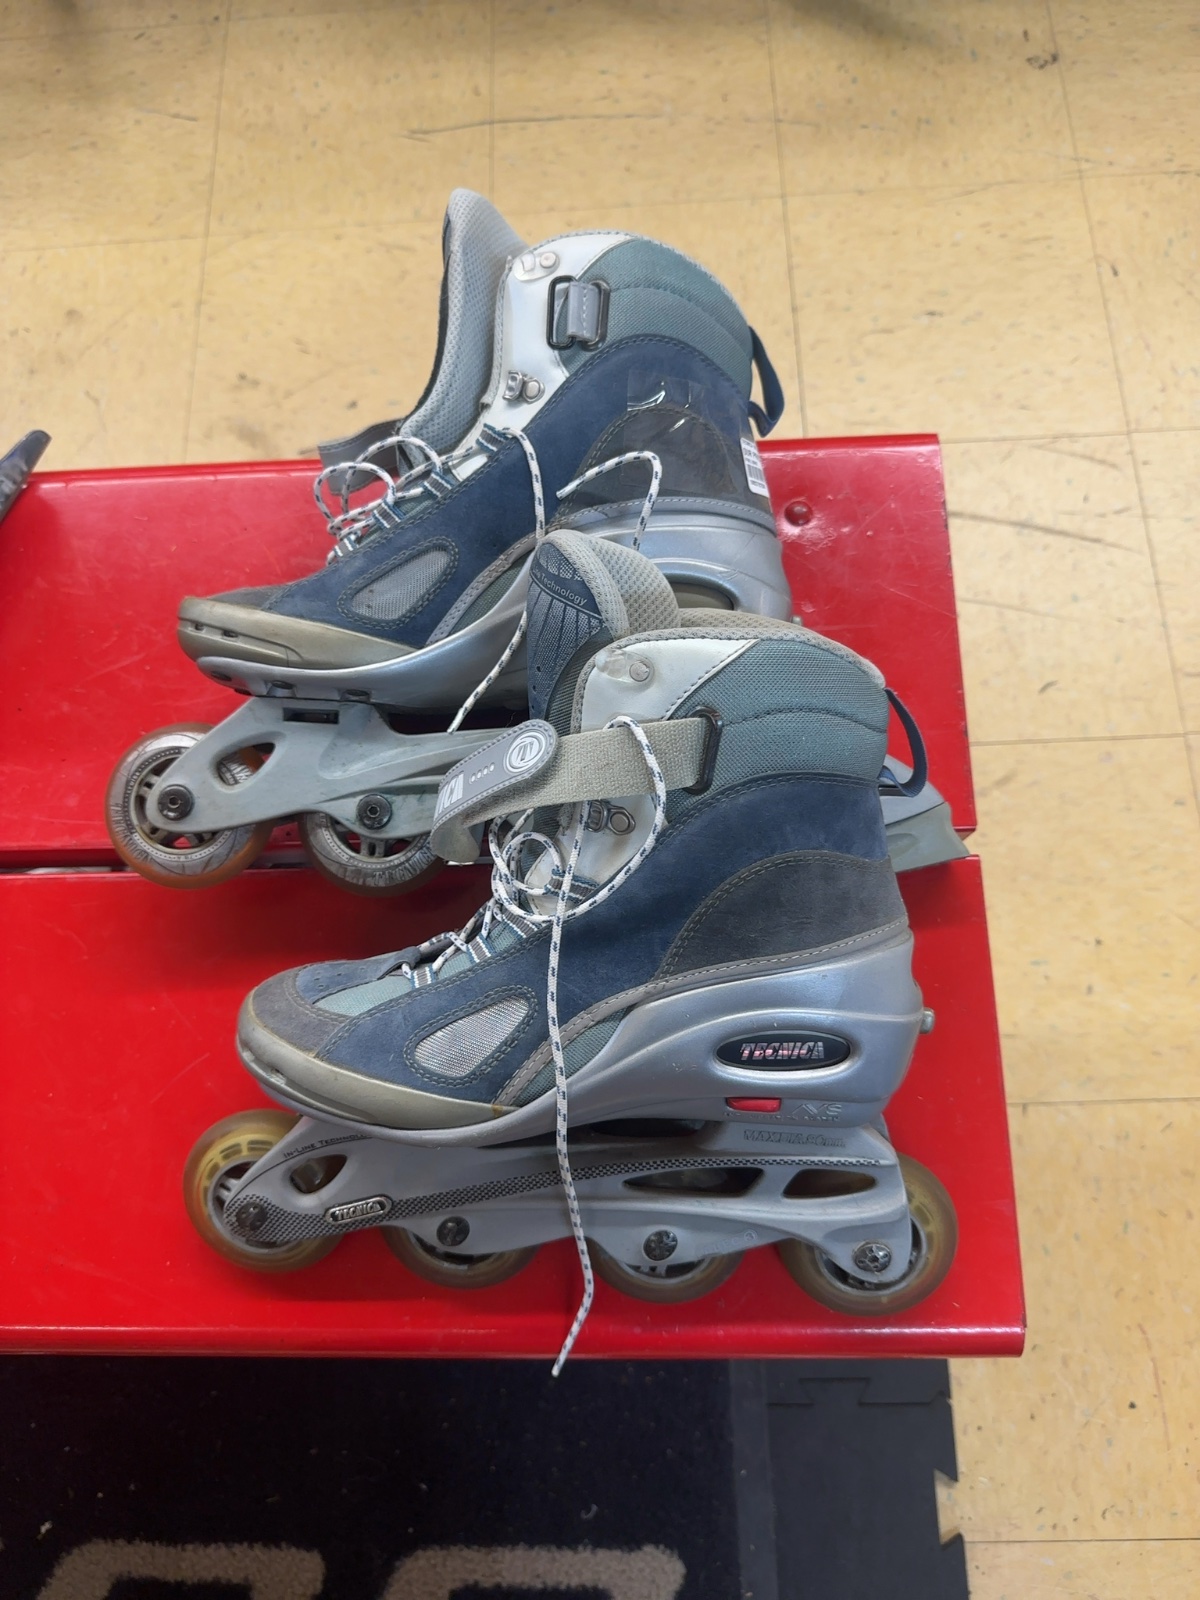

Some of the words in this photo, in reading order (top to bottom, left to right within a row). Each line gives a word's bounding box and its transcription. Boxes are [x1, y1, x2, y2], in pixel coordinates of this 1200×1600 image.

[541, 573, 588, 606] Technology
[740, 1042, 825, 1060] TECNICA
[283, 1143, 316, 1159] IN-LINE
[334, 1202, 381, 1221] TECNICA
